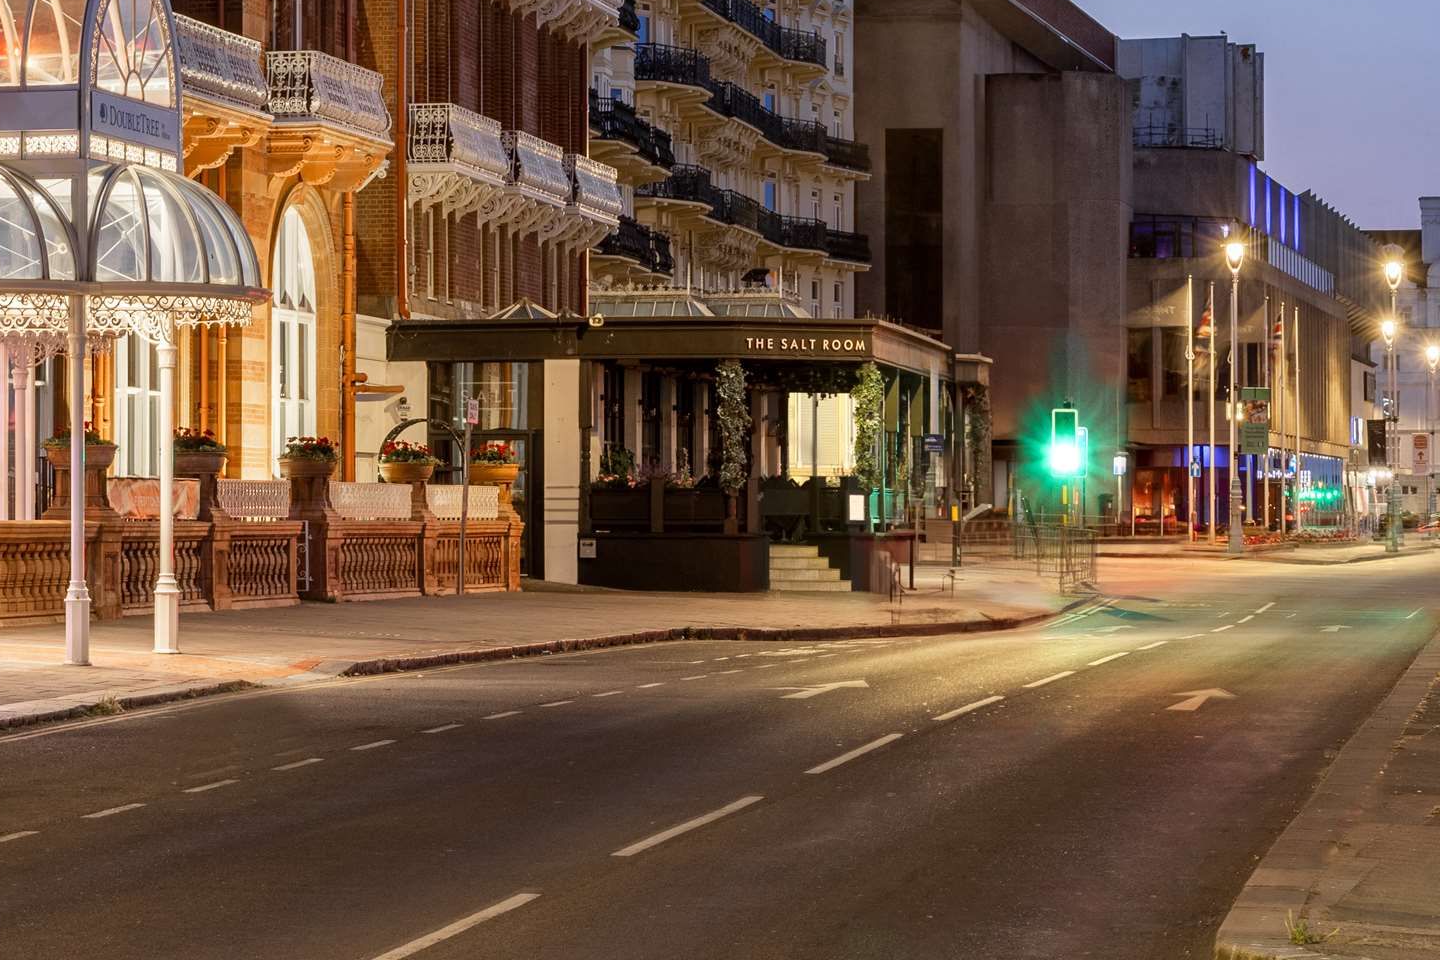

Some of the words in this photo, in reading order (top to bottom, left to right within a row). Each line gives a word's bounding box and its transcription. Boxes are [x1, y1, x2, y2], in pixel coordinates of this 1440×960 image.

[746, 338, 774, 350] THE
[781, 338, 816, 350] SALT
[823, 339, 866, 351] ROOM
